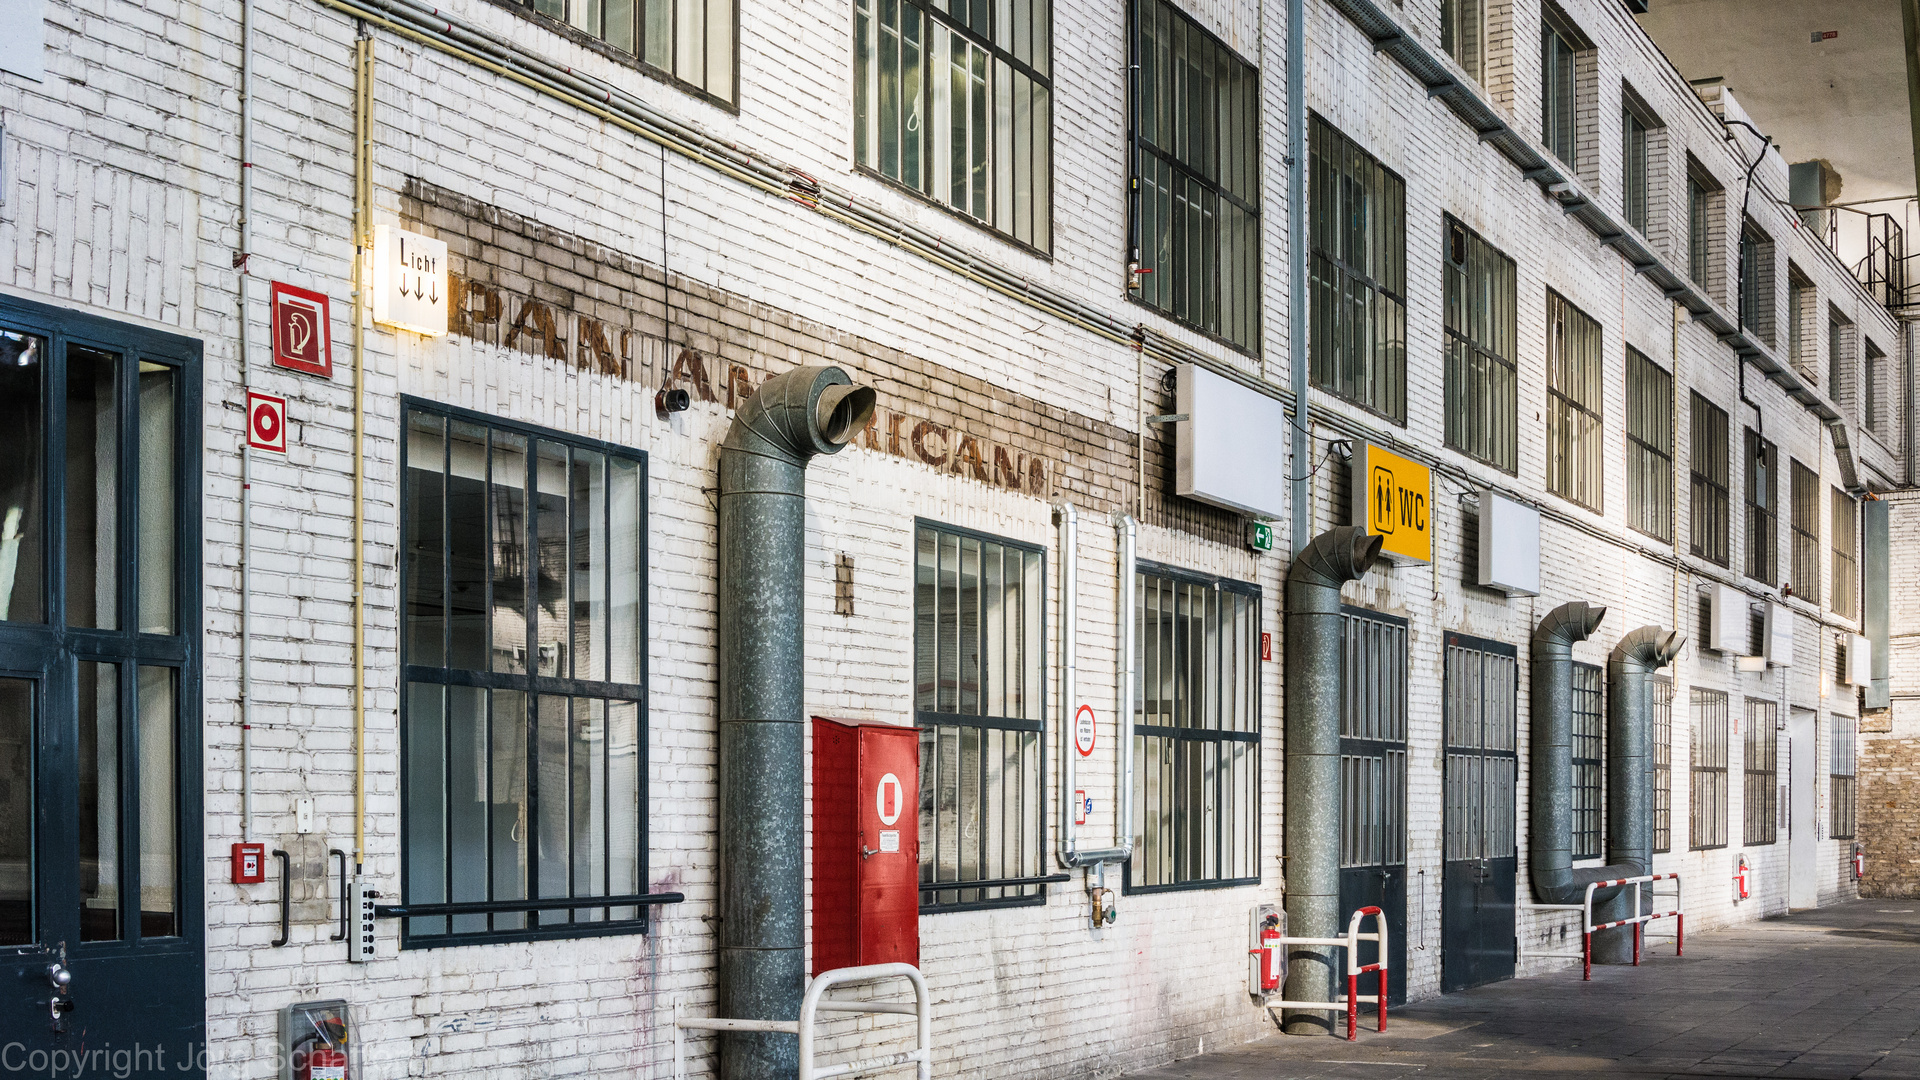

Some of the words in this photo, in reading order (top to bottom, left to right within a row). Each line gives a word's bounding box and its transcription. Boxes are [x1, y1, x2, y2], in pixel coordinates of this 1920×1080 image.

[400, 237, 436, 275] Licht
[447, 274, 632, 380] PAN
[1398, 486, 1424, 532] WC
